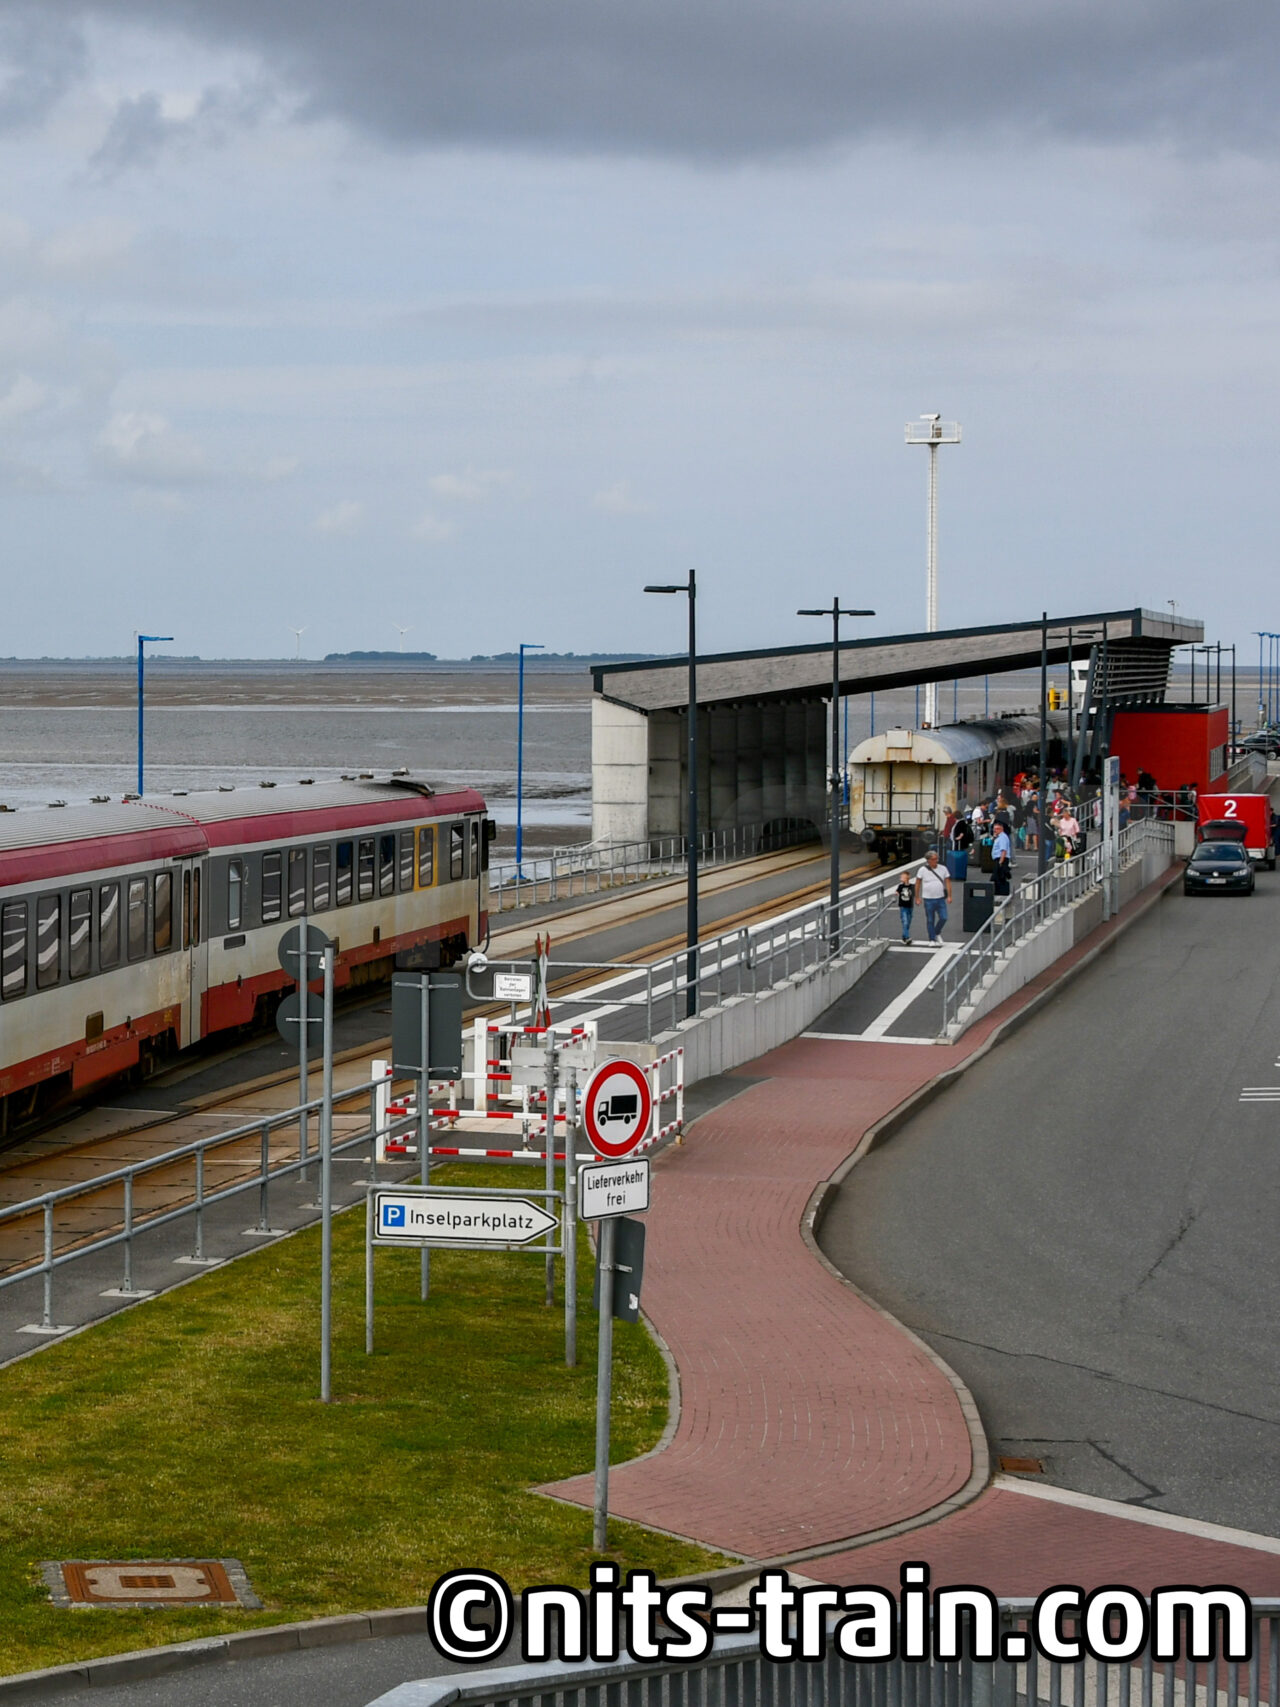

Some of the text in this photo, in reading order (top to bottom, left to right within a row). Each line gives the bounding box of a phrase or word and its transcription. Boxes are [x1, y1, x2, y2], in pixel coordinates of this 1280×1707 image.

[1223, 799, 1238, 818] 2
[587, 1169, 644, 1190] Lieferverkehr
[606, 1190, 626, 1207] frei
[387, 1207, 534, 1231] P Inselparkplatz
